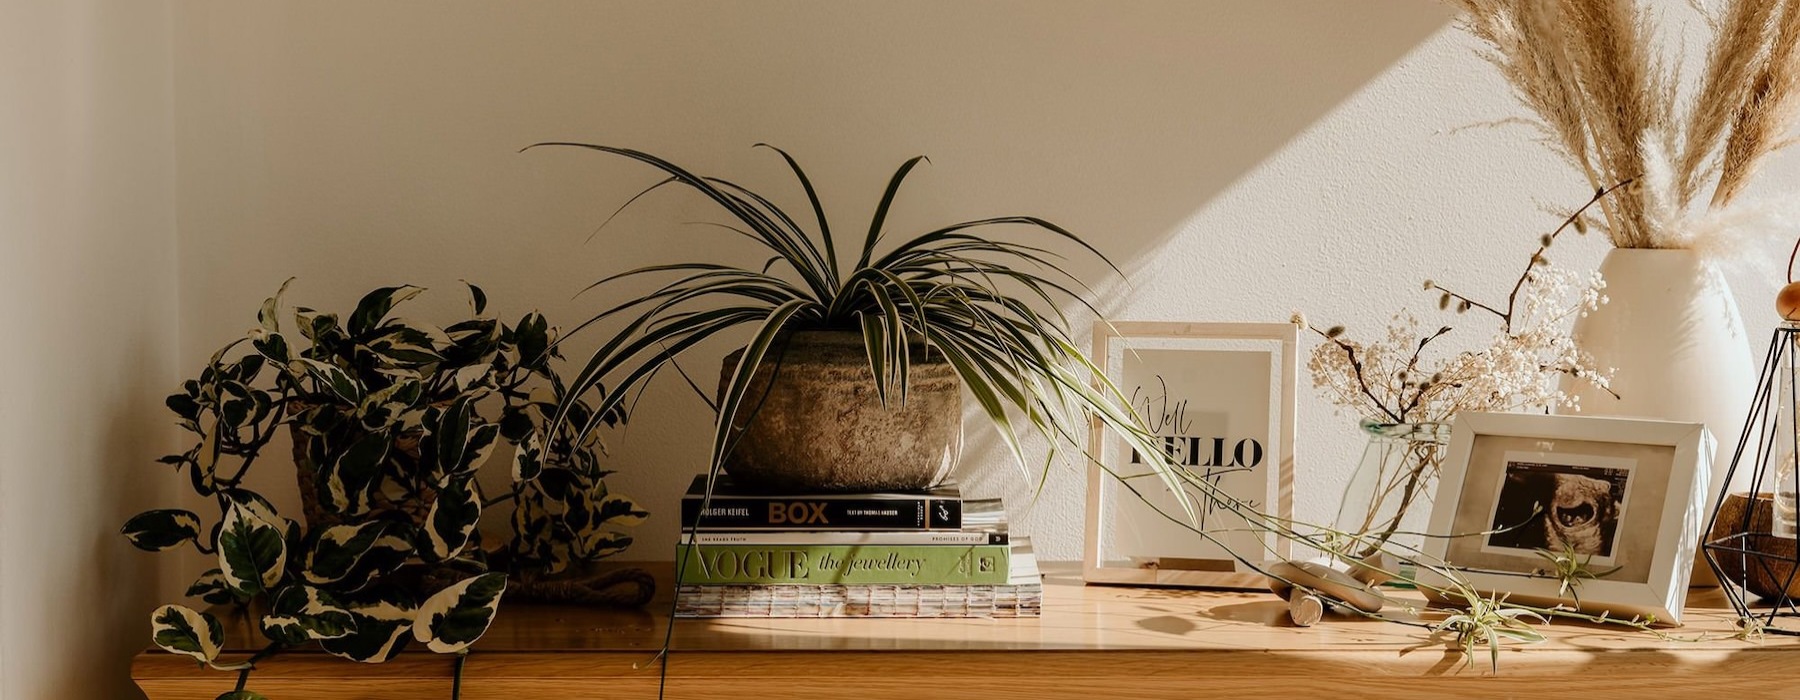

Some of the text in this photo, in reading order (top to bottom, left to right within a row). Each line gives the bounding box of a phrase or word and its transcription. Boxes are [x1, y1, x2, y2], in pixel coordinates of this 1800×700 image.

[1129, 374, 1192, 434] Well
[727, 508, 750, 516] KEIFEL
[768, 502, 829, 524] BOX
[697, 549, 926, 580] VOGUE the jewellery
